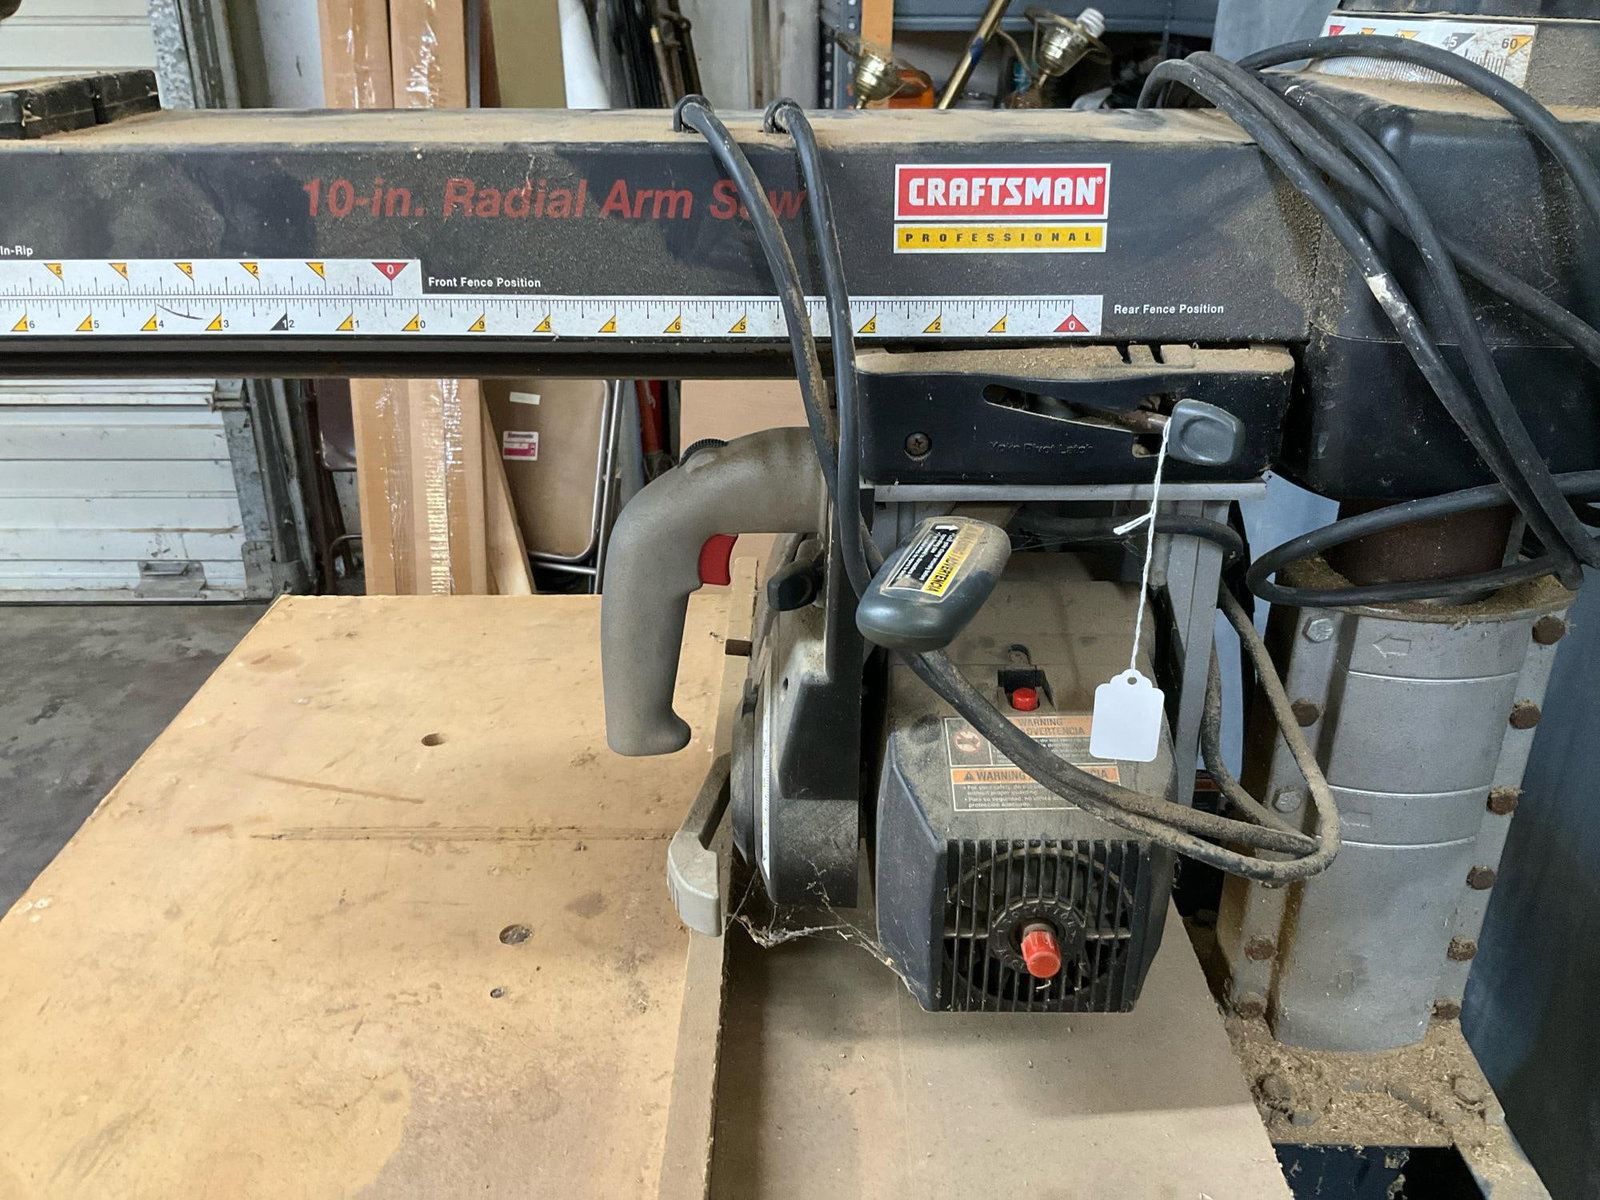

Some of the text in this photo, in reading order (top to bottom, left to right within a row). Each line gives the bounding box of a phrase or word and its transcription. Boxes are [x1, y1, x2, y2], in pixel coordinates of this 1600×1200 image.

[1441, 34, 1518, 50] 45 60
[302, 177, 808, 220] 10-in. Radial Arm Sw
[905, 232, 1092, 243] PROFESSIONAL
[0, 245, 34, 258] In-Rip
[56, 264, 394, 275] 5 4 3 2 1 0
[428, 276, 541, 289] Front Fence Position
[1113, 302, 1225, 315] Rear Fence Position
[23, 319, 36, 329] 16
[87, 319, 100, 329] 15
[152, 319, 165, 329] 14
[218, 319, 230, 329] 13
[282, 319, 295, 329] 12
[348, 319, 360, 329] 11
[413, 319, 426, 329] 10
[478, 321, 485, 330] 9
[610, 321, 616, 331] 7
[674, 321, 682, 331] 6
[739, 321, 746, 331] 5
[869, 321, 876, 331] 3
[934, 321, 942, 331] 2
[1001, 321, 1006, 331] 1
[1068, 321, 1076, 331] 0
[976, 770, 1026, 781] WARNING
